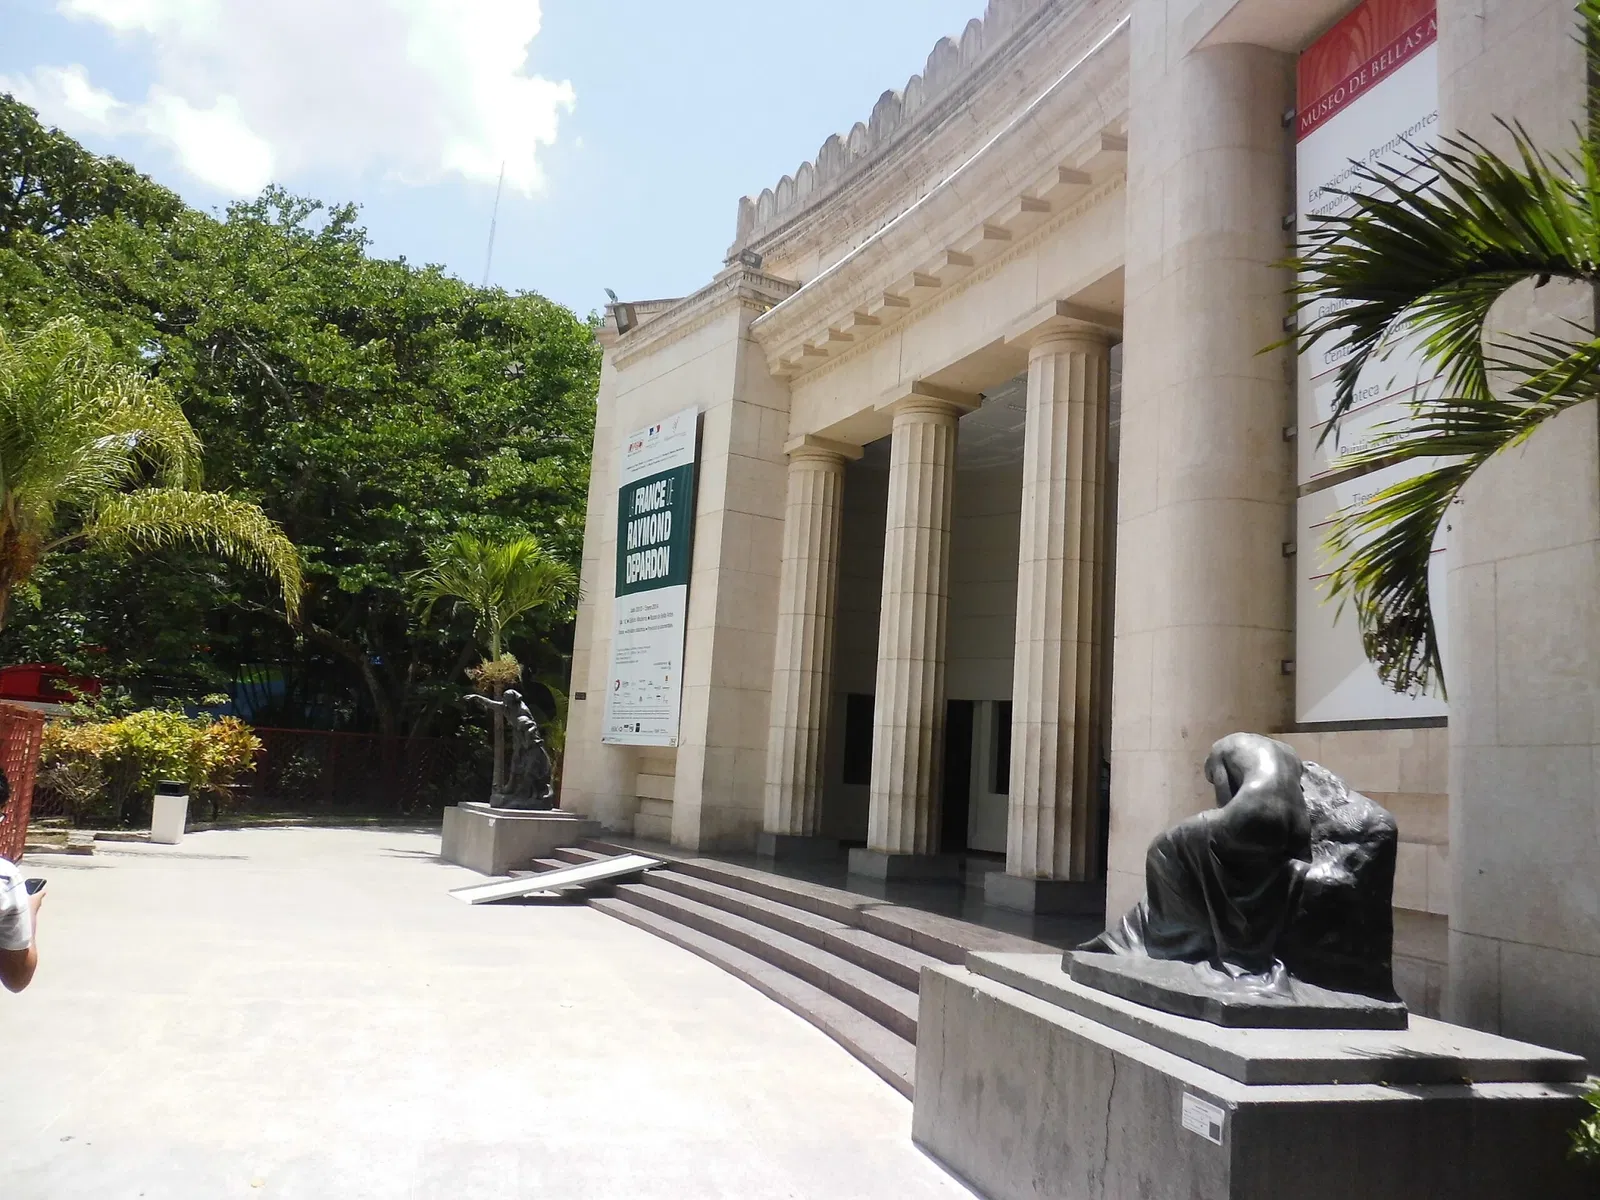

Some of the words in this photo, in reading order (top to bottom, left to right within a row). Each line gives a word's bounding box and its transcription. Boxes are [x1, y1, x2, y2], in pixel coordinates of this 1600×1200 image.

[1301, 89, 1346, 130] MUSEO
[1348, 73, 1367, 94] DE
[1371, 29, 1423, 77] BELLAS
[1368, 109, 1439, 163] Permanentes
[1318, 298, 1354, 318] Gabine
[635, 480, 666, 515] FRANCE
[627, 511, 672, 550] RAYMOND
[627, 546, 670, 584] DEPARDON
